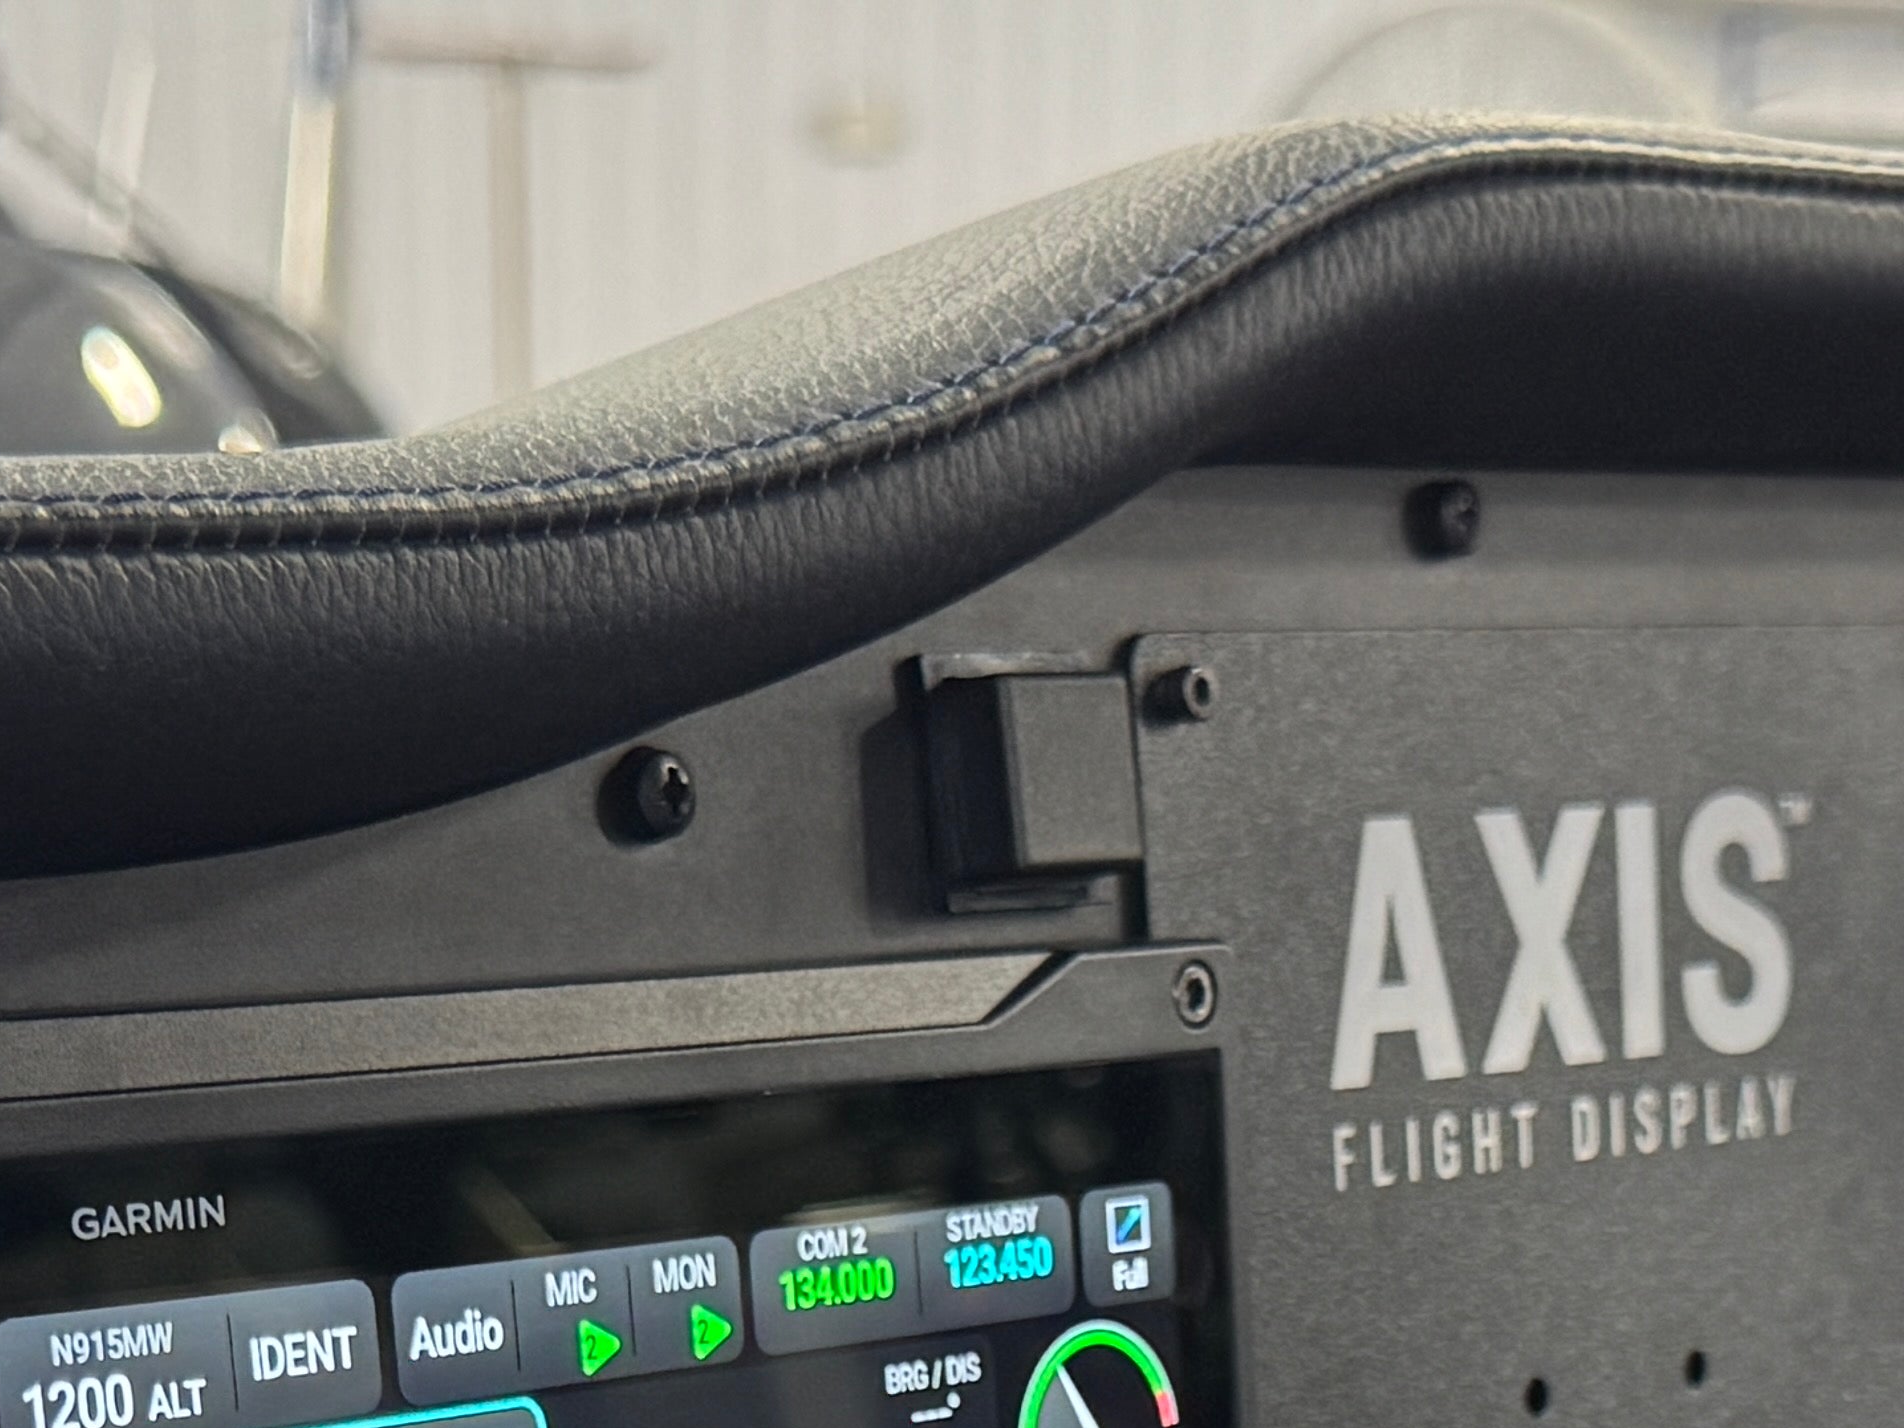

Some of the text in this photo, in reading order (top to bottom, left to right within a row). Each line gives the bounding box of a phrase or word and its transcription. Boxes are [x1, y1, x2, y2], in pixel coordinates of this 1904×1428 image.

[1330, 789, 1793, 1090] AXIS
[1331, 1072, 1795, 1192] FLIGHT DISPLAY
[70, 1196, 227, 1241] GARMIN
[946, 1205, 1040, 1242] STANDBY
[798, 1227, 868, 1261] COM 2
[944, 1236, 1054, 1288] 123.450
[544, 1267, 598, 1309] MIC
[652, 1253, 717, 1295] MON
[778, 1257, 895, 1311] 134.000
[50, 1321, 173, 1369] N915MW
[250, 1326, 359, 1379] IDENT
[410, 1312, 504, 1361] Audio
[148, 1377, 208, 1424] ALT
